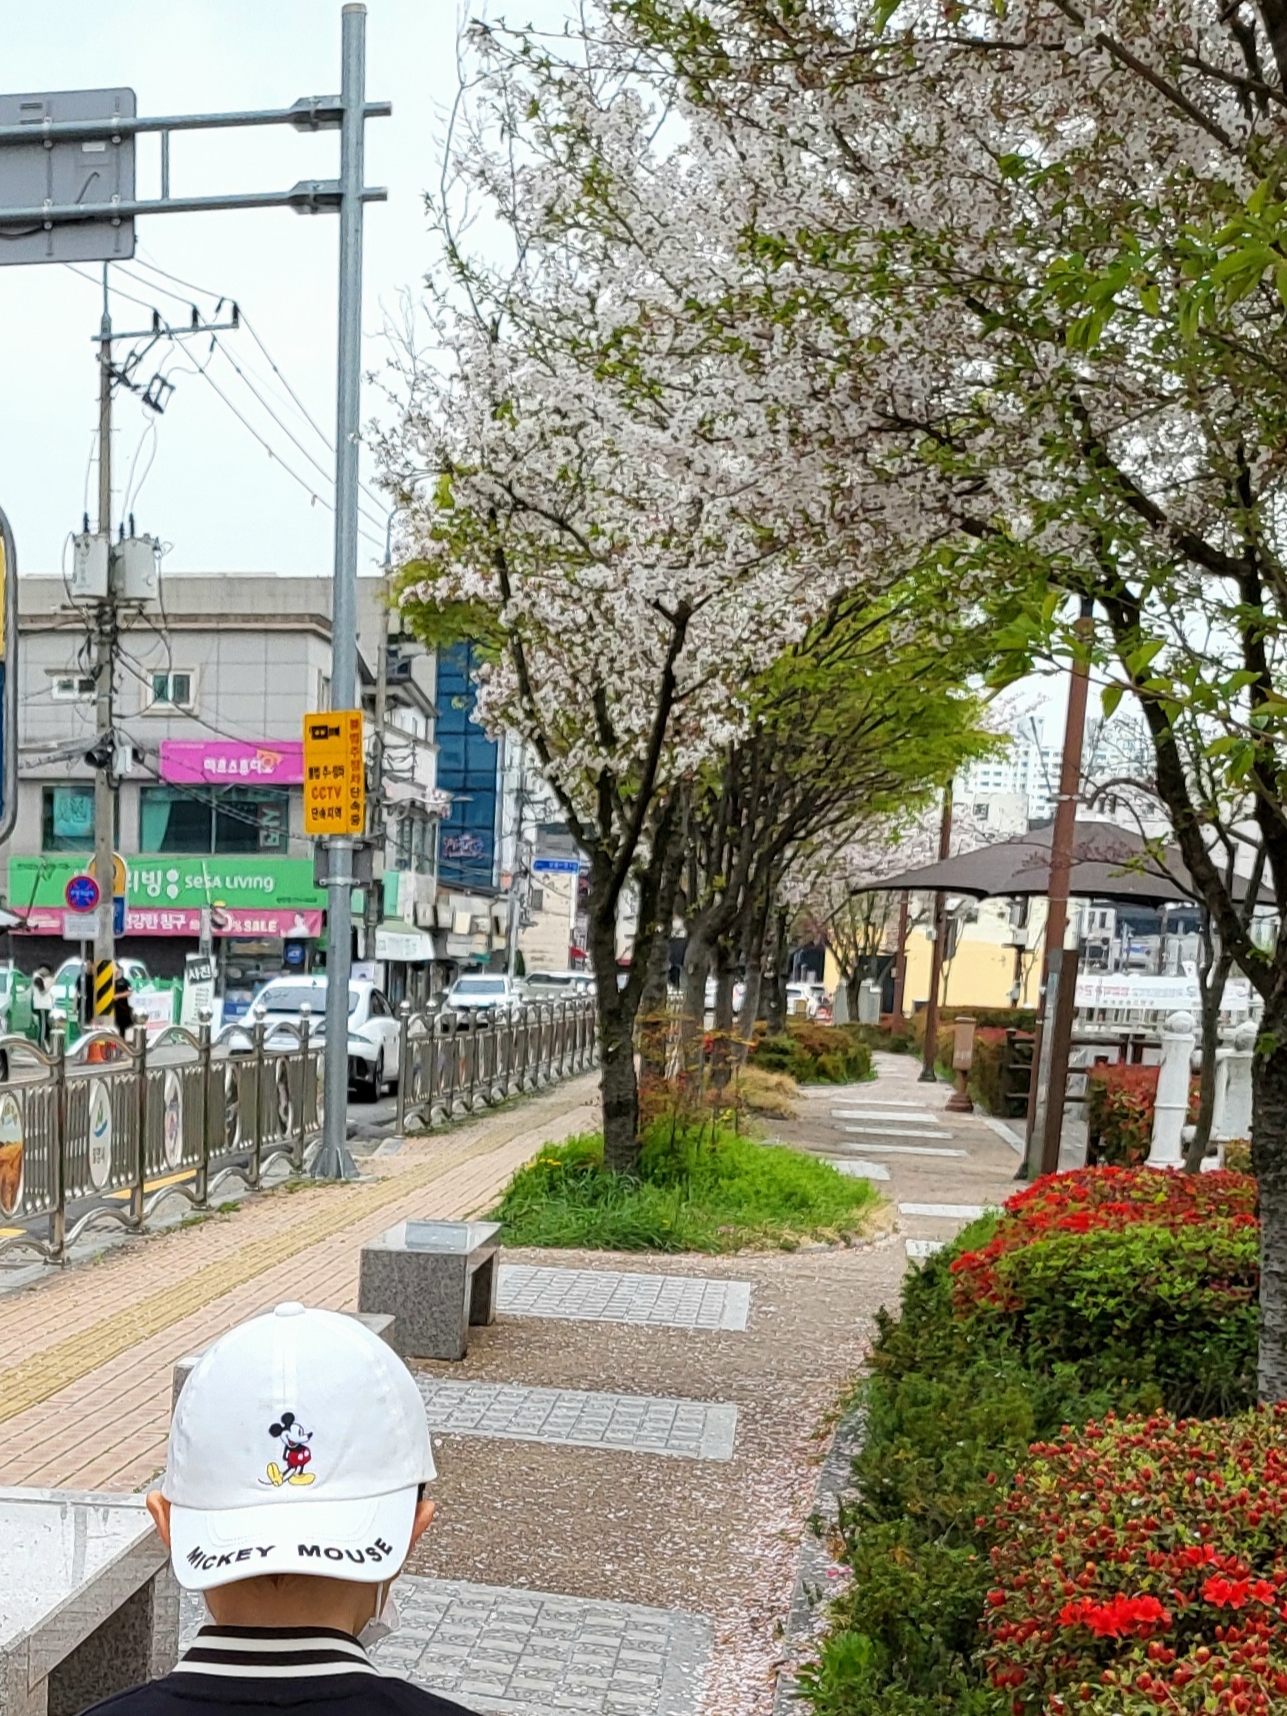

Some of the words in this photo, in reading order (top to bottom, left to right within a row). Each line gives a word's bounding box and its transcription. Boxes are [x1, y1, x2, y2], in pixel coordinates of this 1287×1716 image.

[311, 786, 342, 800] CCTV
[244, 920, 278, 933] SALE
[187, 1544, 276, 1571] MICKEY
[297, 1537, 394, 1566] MOUSE
